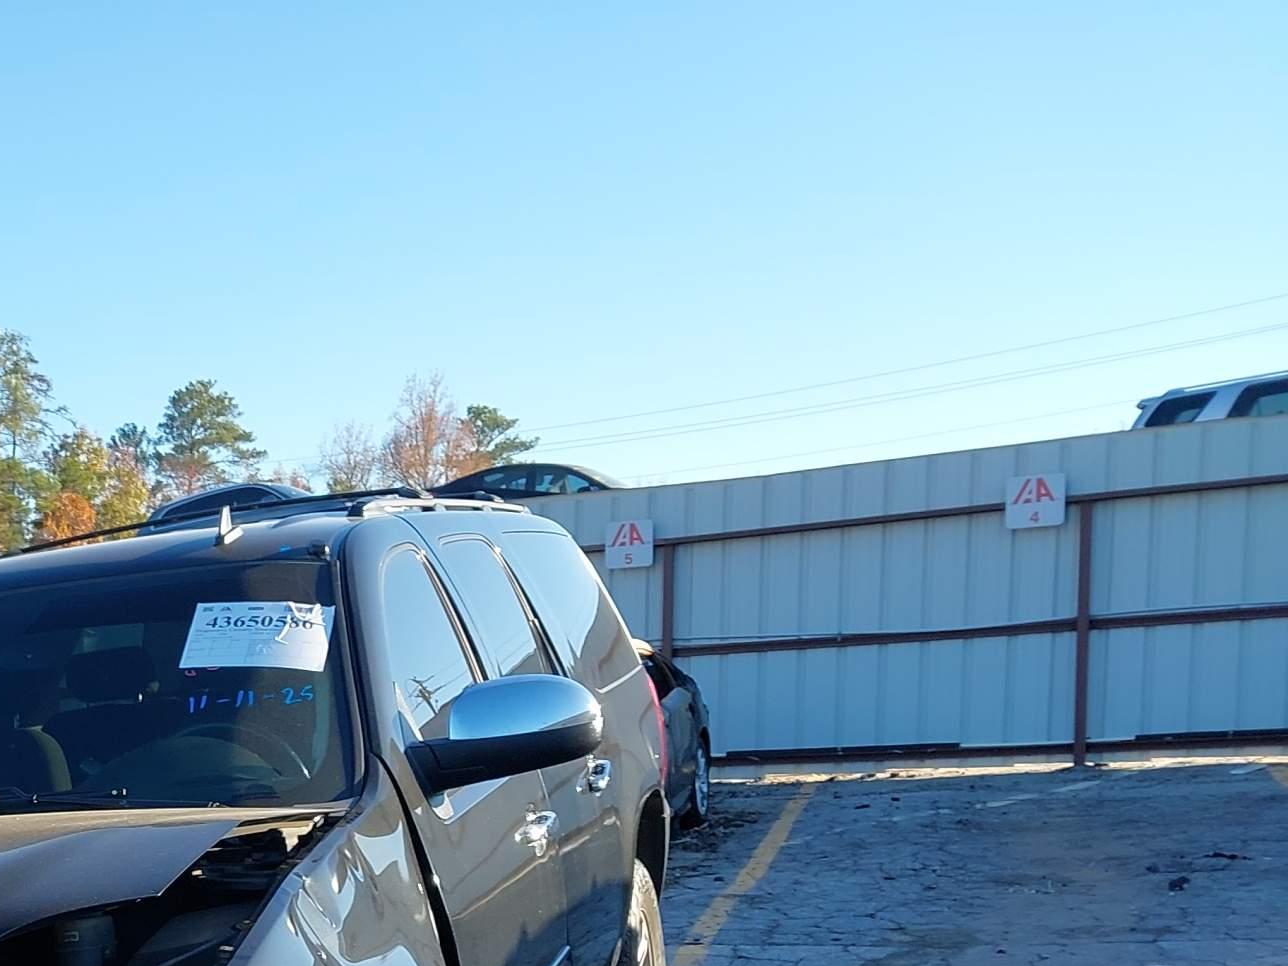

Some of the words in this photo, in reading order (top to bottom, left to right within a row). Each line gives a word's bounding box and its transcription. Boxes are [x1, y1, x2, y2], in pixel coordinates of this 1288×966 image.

[1030, 511, 1040, 523] 4
[624, 552, 633, 565] 5
[205, 614, 313, 630] 43650586
